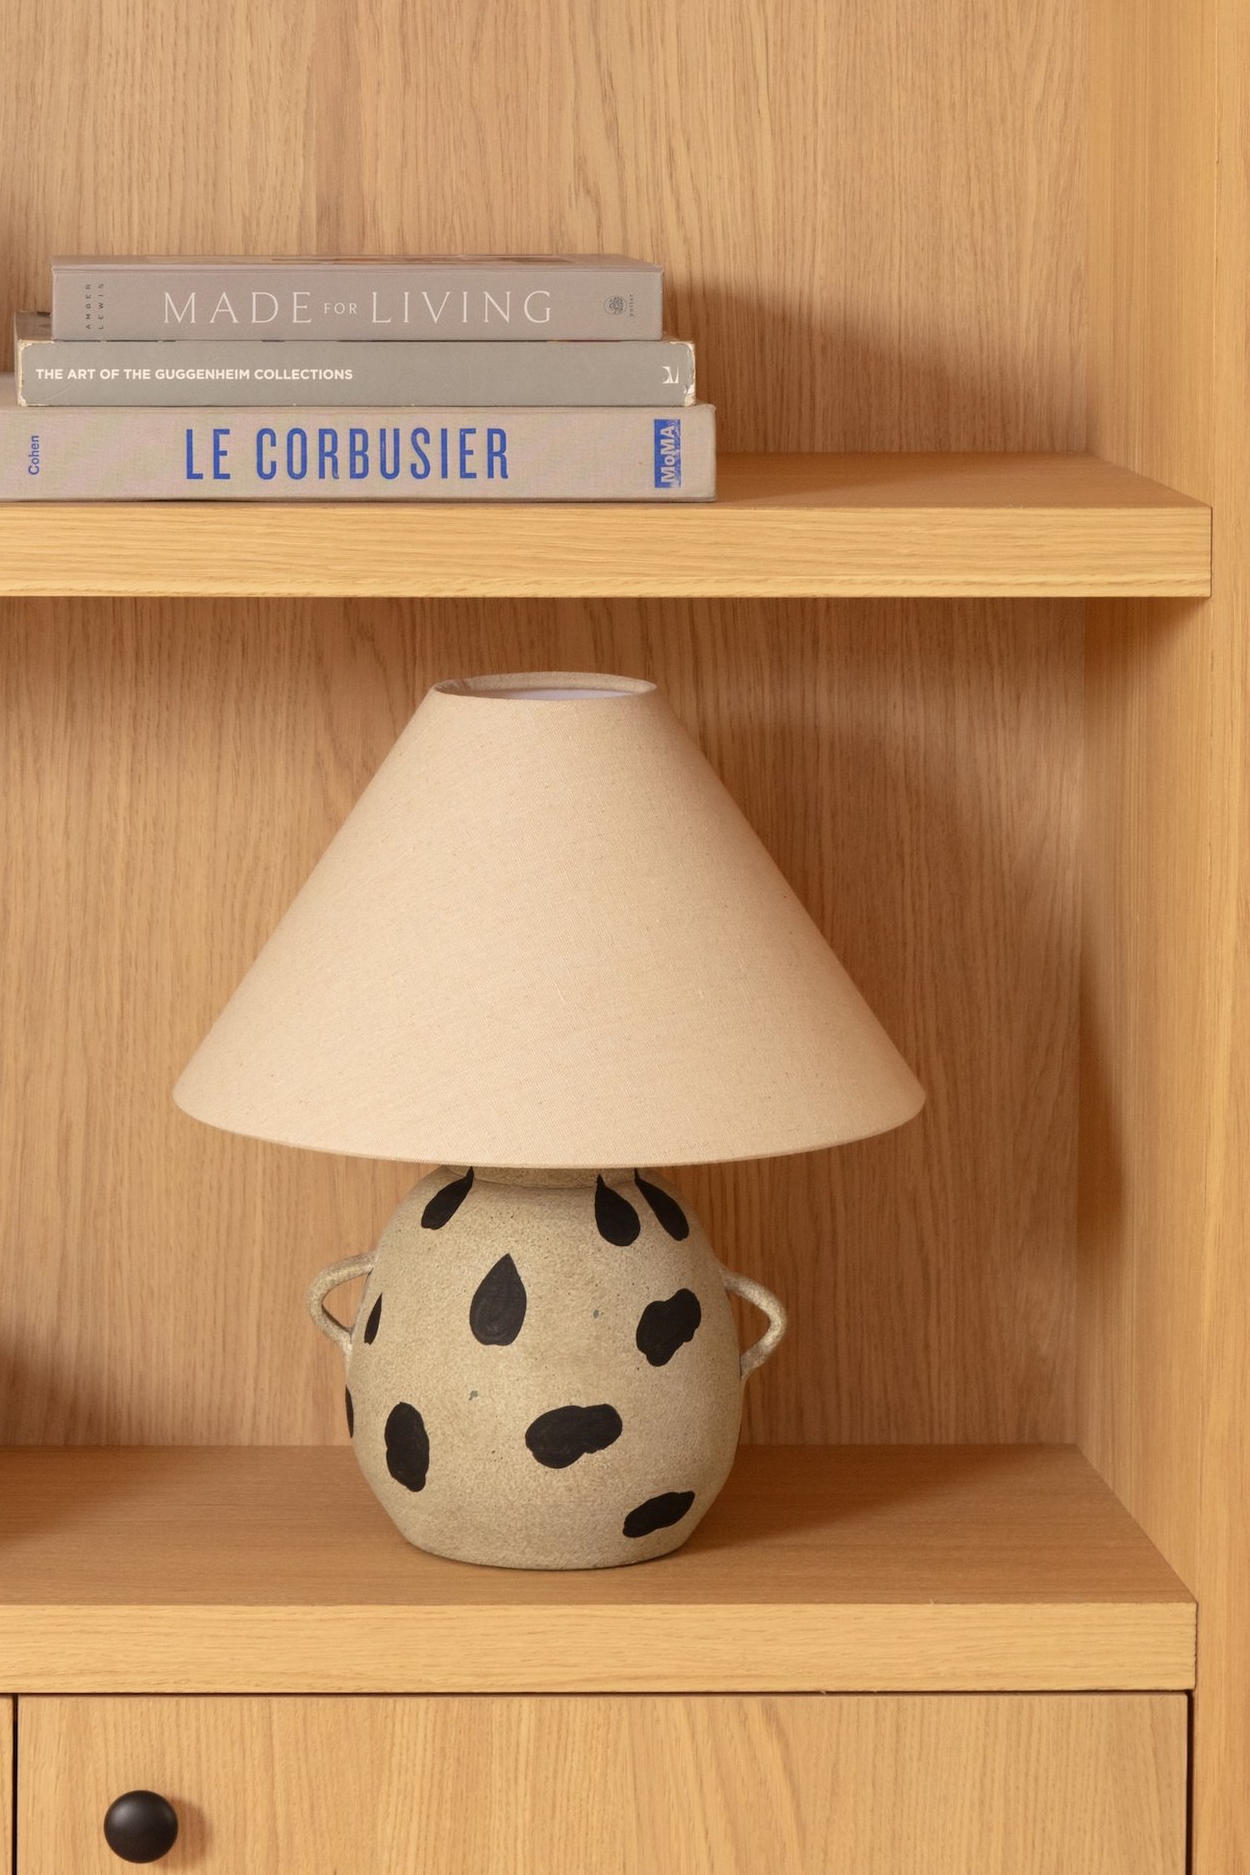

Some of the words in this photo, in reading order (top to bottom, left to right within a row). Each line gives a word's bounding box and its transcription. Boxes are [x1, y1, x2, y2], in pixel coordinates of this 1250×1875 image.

[163, 291, 312, 324] MADE
[323, 302, 358, 315] FOR
[371, 290, 552, 324] LIVING
[35, 368, 63, 381] THE
[67, 368, 96, 381] ART
[99, 368, 120, 381] OF
[123, 368, 151, 381] THE
[155, 368, 250, 381] GUGGENHEIM
[253, 368, 353, 381] COLLECTIONS
[28, 434, 40, 476] Cohen
[186, 428, 231, 480] LE
[256, 427, 509, 480] CORBUSIER
[660, 426, 675, 482] MoMA
